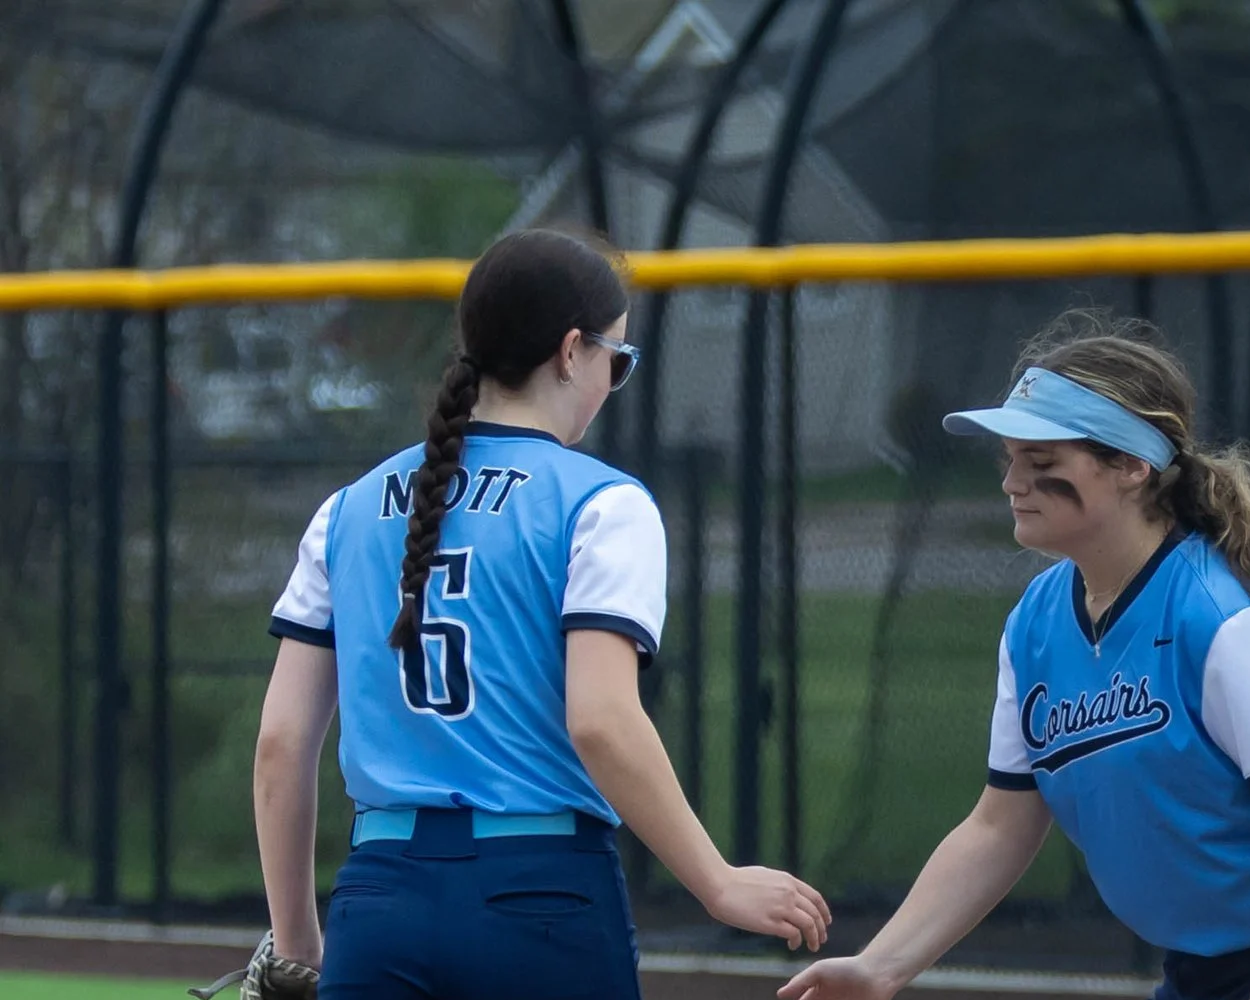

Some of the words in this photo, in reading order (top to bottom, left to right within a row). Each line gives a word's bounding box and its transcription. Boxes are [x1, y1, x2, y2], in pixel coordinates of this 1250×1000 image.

[379, 465, 533, 520] MOTT
[400, 546, 475, 721] 6
[1020, 672, 1158, 750] Corsairs
